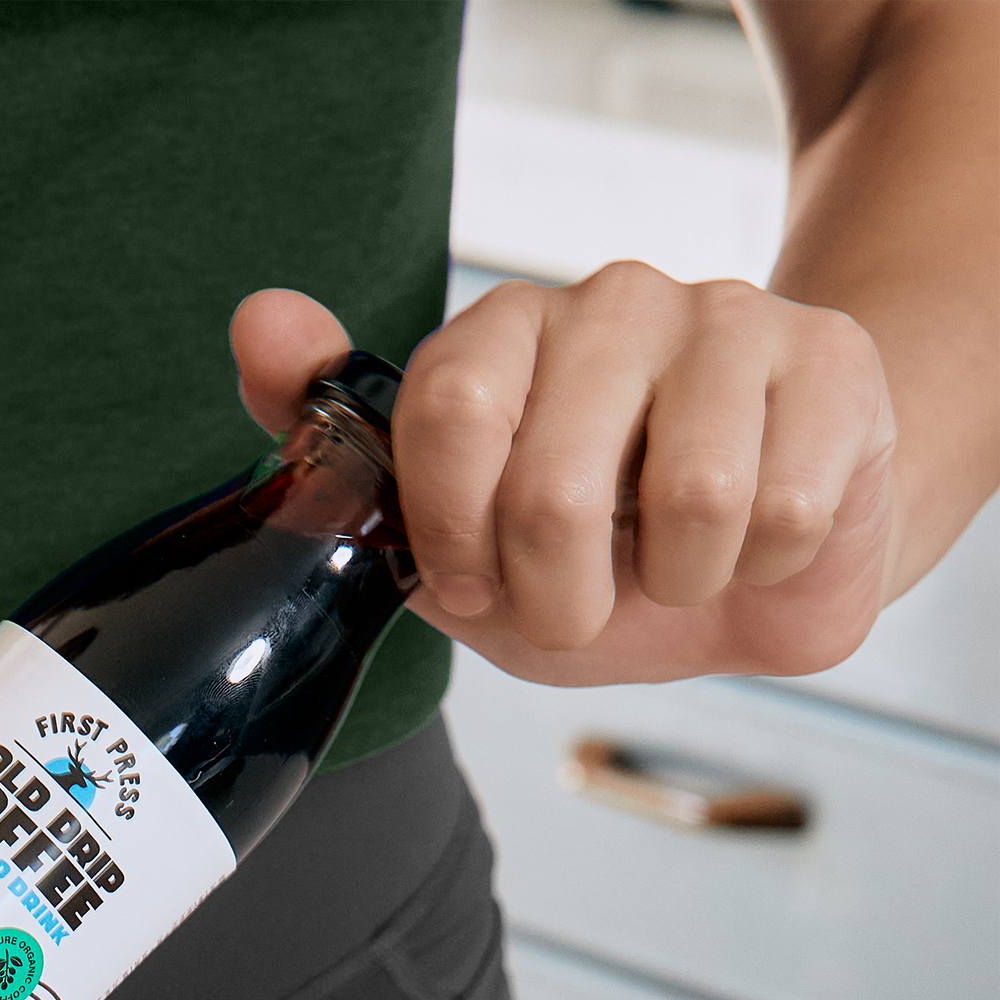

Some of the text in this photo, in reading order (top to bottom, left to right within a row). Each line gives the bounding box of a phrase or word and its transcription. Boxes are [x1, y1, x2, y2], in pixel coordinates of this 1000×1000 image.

[35, 712, 141, 820] FIRST PRESS
[46, 807, 125, 893] DRIP
[7, 875, 70, 947] DRINK
[19, 941, 36, 984] ORGANIC
